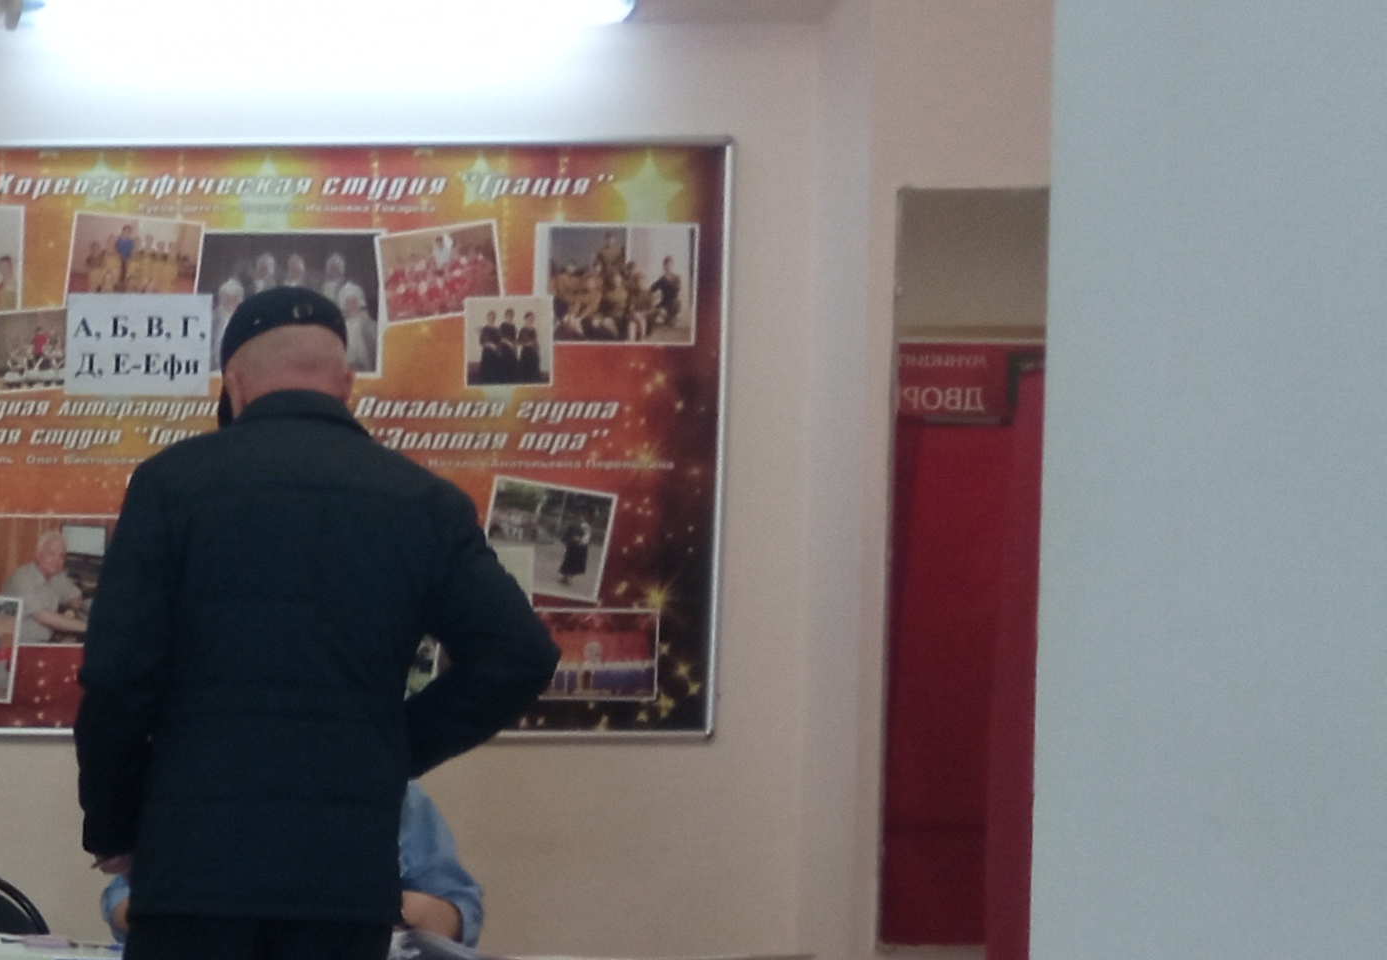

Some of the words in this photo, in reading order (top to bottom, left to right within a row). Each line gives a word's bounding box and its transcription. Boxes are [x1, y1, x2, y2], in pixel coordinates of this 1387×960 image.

[321, 174, 447, 201] студия
[74, 316, 102, 341] А,
[111, 315, 137, 341] Б,
[146, 315, 172, 341] В,
[182, 315, 206, 341] Г,
[75, 353, 104, 379] Д,
[113, 352, 199, 382] Е-Ефи
[353, 396, 508, 419] Вокальная
[515, 400, 620, 425] группа
[29, 428, 123, 450] студия
